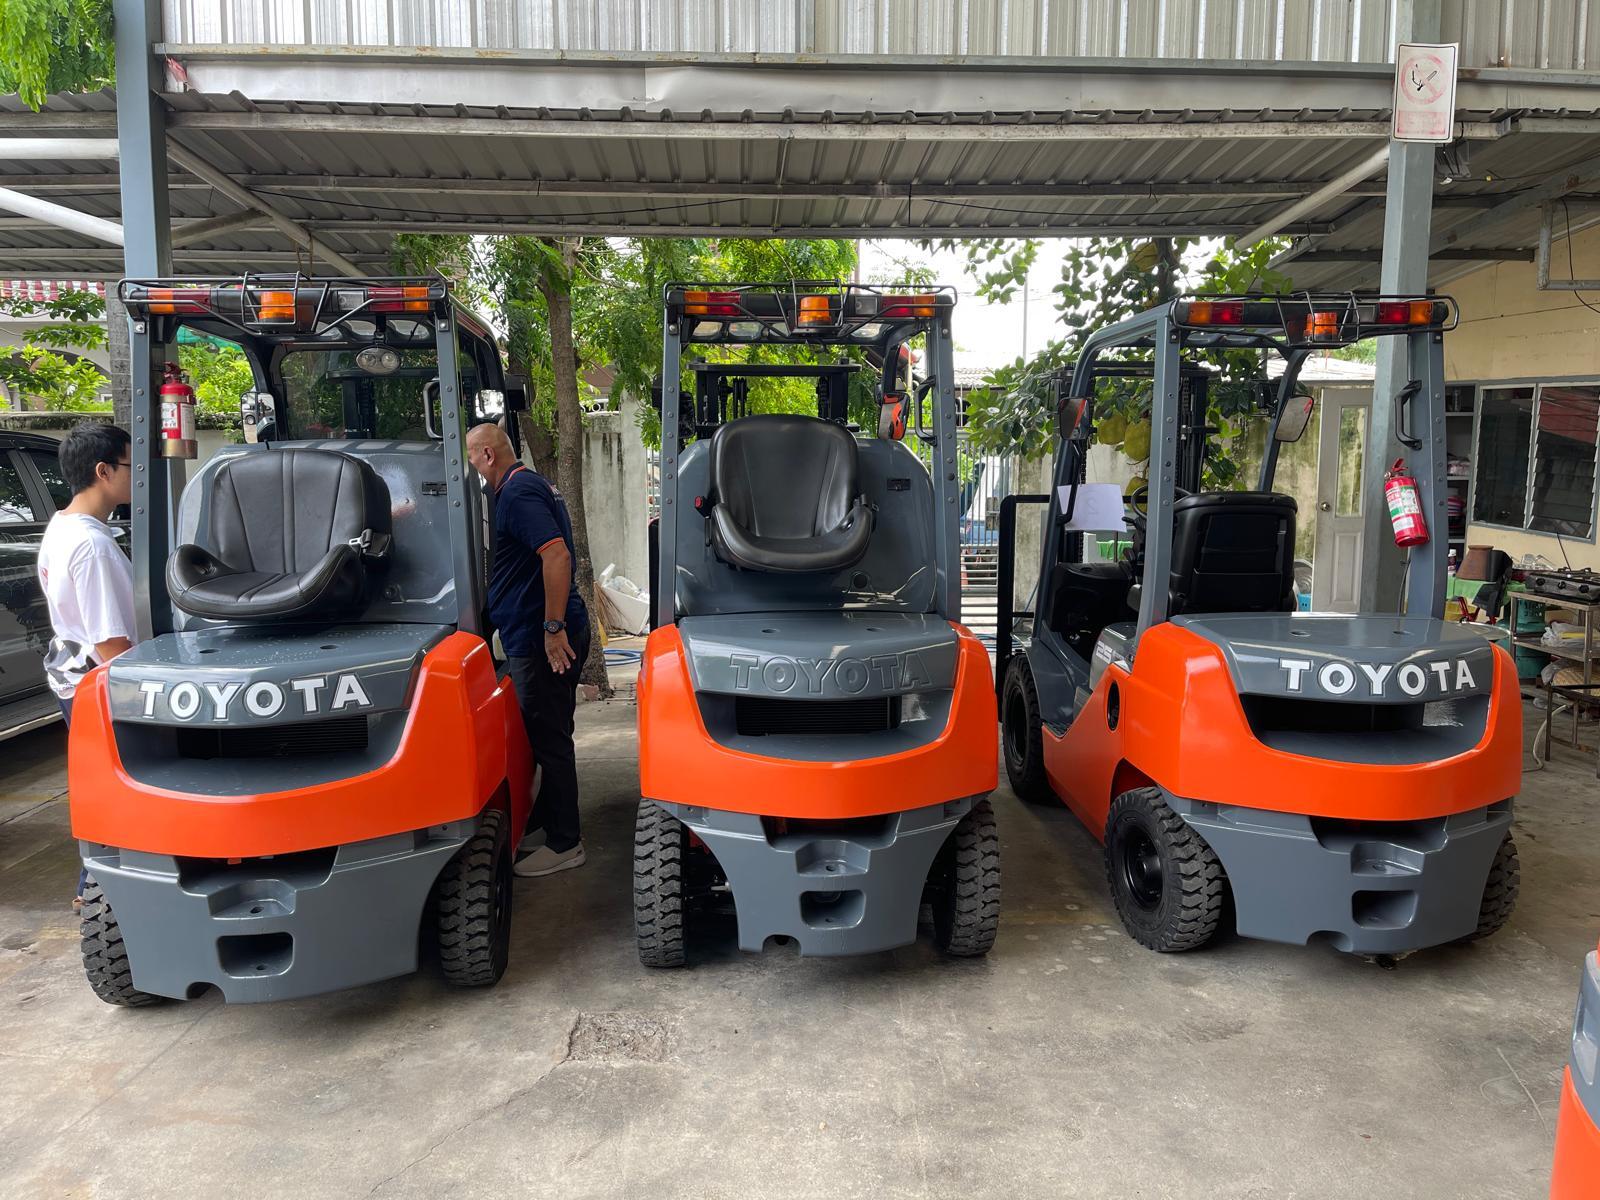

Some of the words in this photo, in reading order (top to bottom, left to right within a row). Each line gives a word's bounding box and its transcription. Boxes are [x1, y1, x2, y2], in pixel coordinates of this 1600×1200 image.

[729, 651, 932, 695] TOYOTA
[1279, 658, 1477, 697] TOYOTA
[139, 673, 373, 720] TOYOTA
